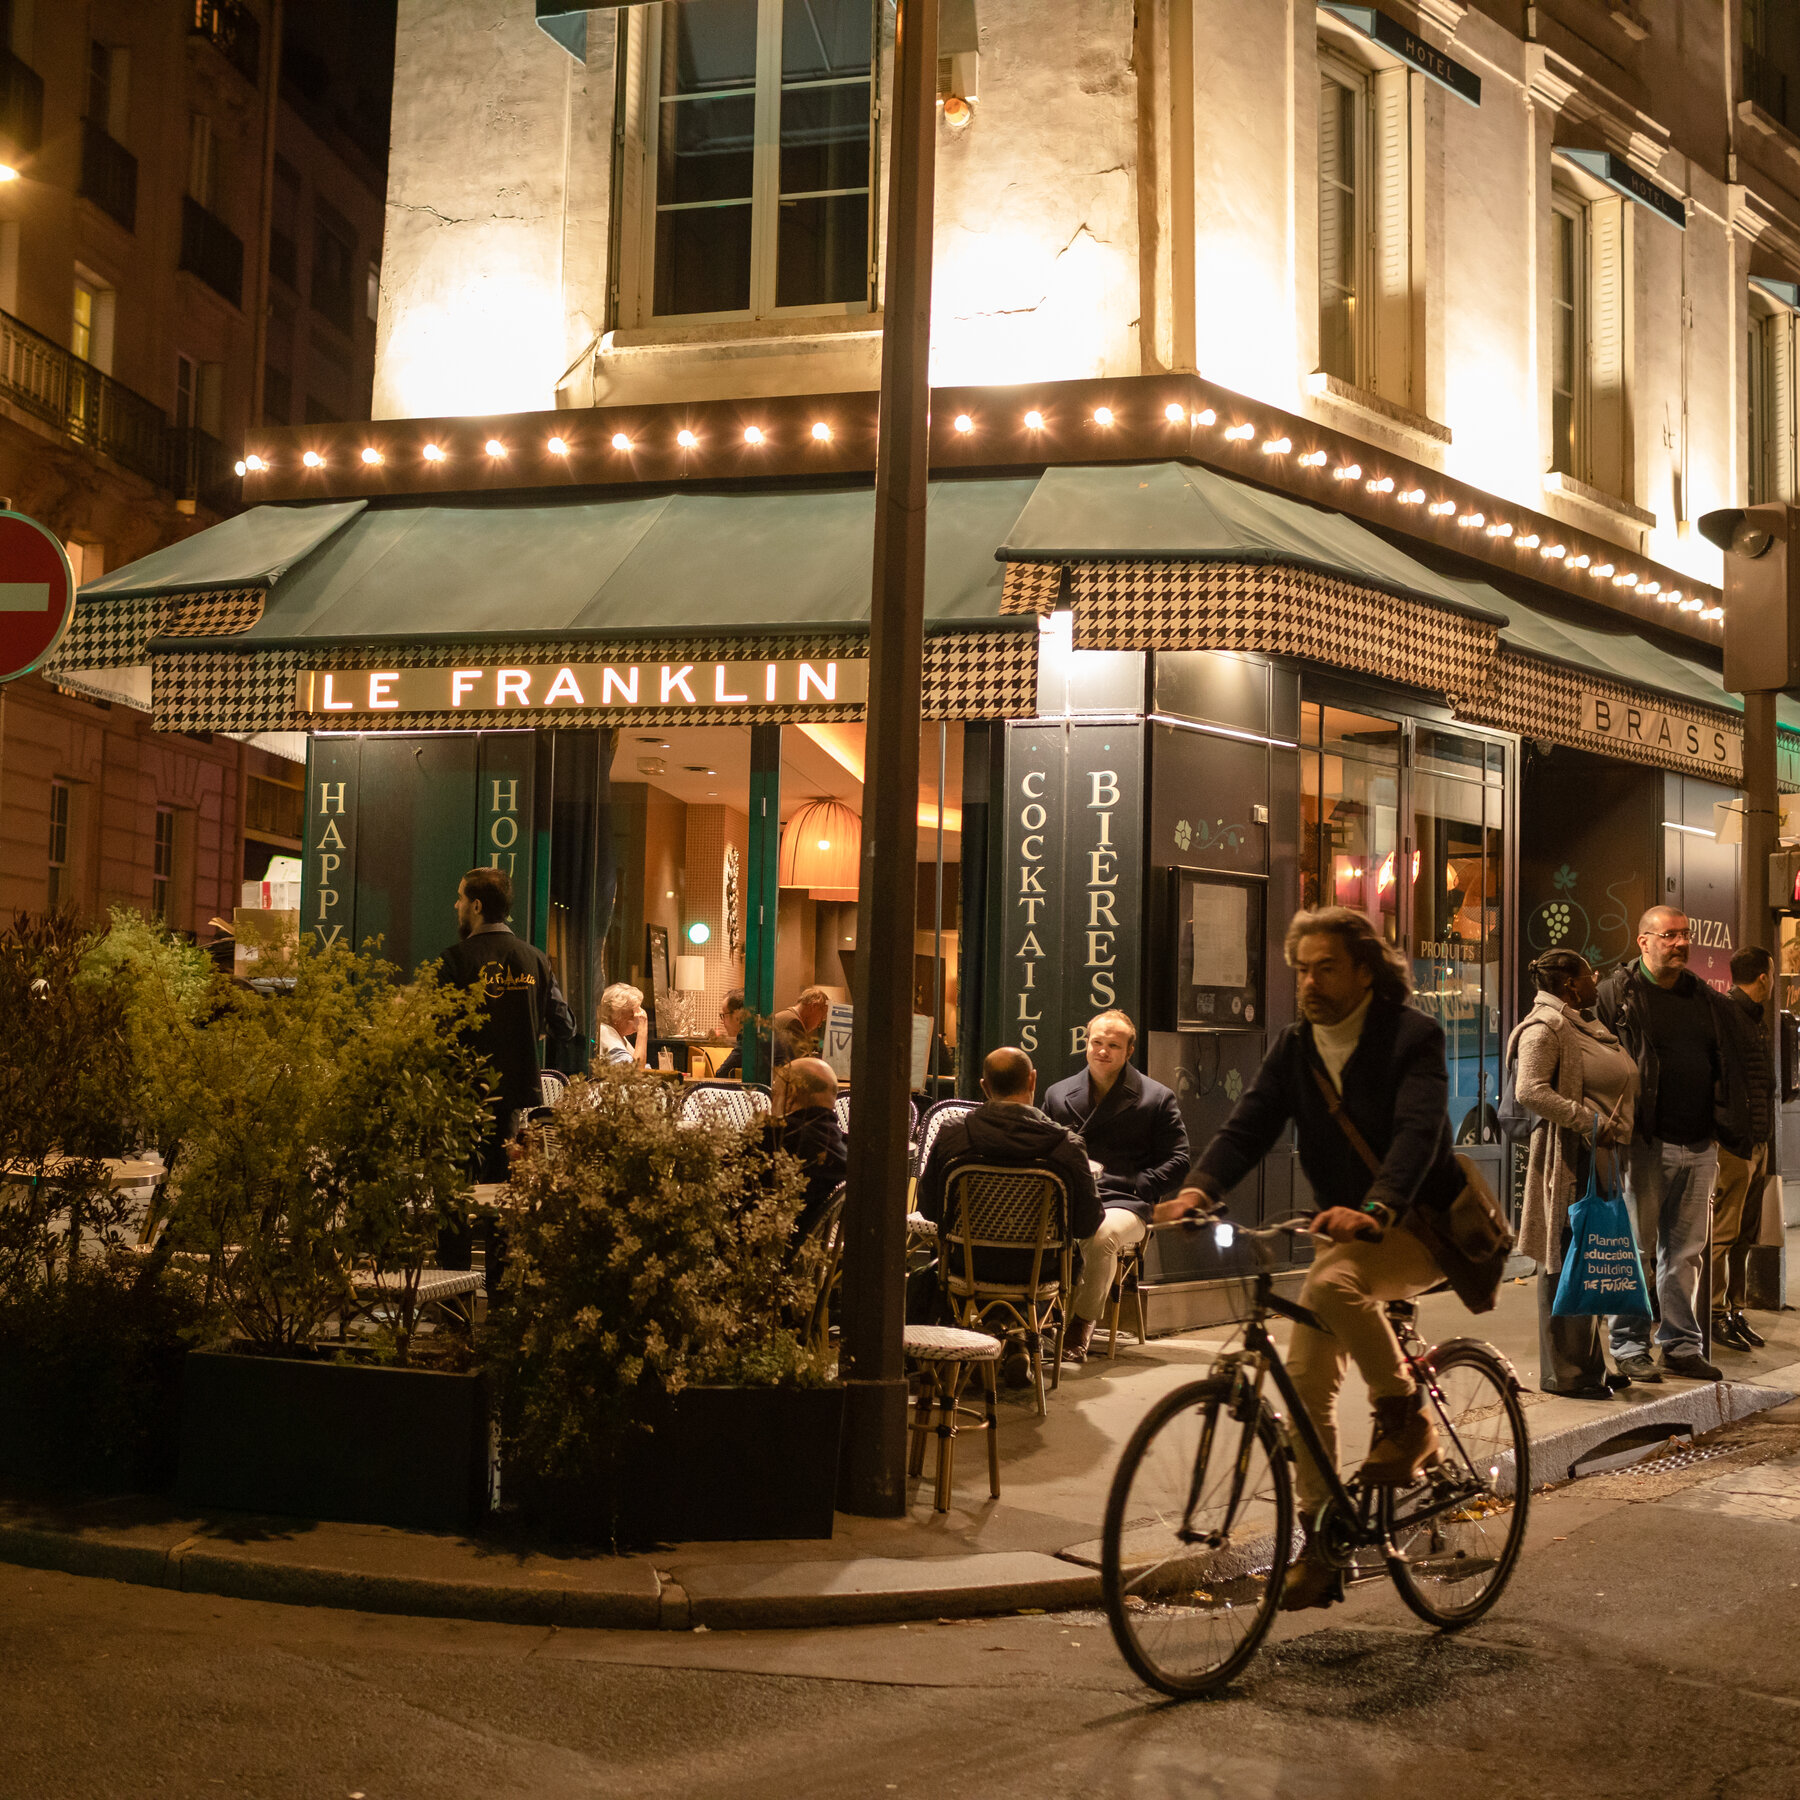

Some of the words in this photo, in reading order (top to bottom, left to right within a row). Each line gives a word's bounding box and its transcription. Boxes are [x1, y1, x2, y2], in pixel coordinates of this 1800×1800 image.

[1406, 37, 1454, 82] HOTEL
[1631, 175, 1668, 212] HOTEL
[323, 672, 400, 710] LE
[451, 662, 838, 707] FRANKLIN
[314, 782, 347, 950] HAPPY
[1085, 769, 1121, 1009] BIÈRES
[1015, 771, 1047, 1052] COCKTAILS
[1420, 940, 1475, 961] PRODUITS
[1688, 917, 1733, 949] PIZZA
[1707, 956, 1714, 968] &
[1587, 1262, 1633, 1276] building
[1600, 1277, 1637, 1294] FUTURE
